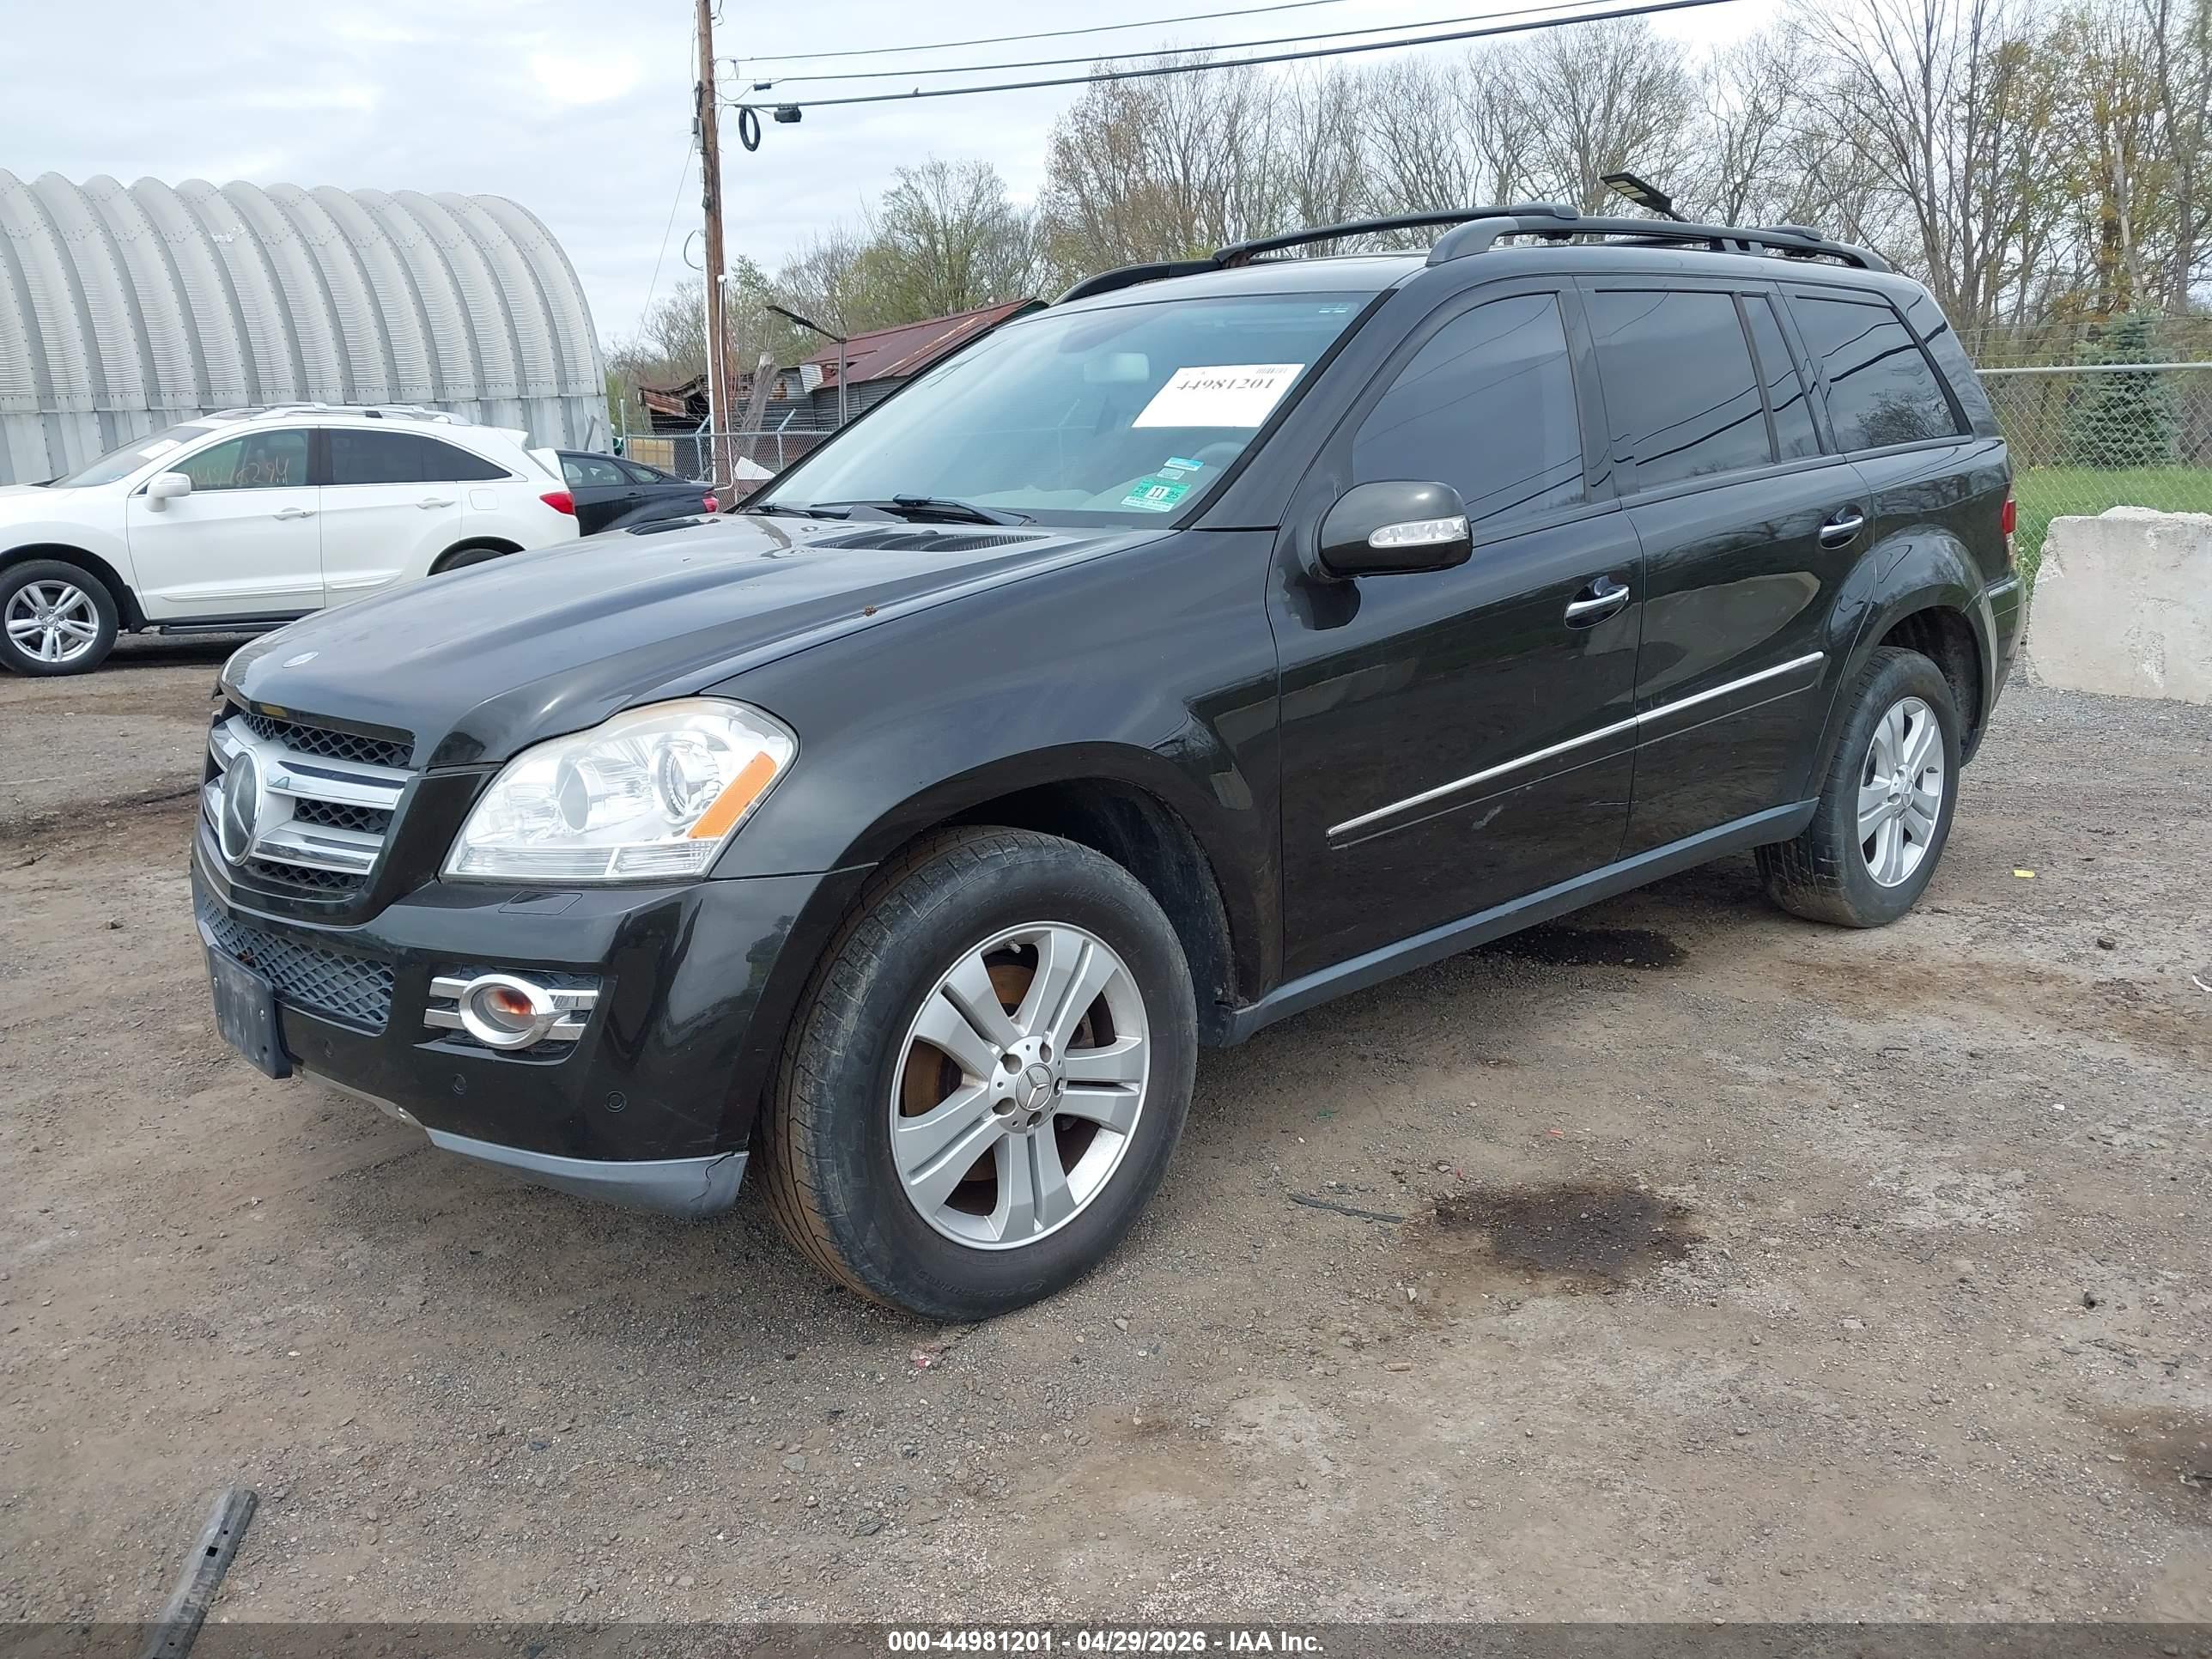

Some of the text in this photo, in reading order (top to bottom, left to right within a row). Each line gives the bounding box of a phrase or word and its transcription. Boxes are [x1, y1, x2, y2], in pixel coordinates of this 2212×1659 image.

[1176, 378, 1275, 391] 44981201
[1134, 485, 1180, 499] 20 11 25
